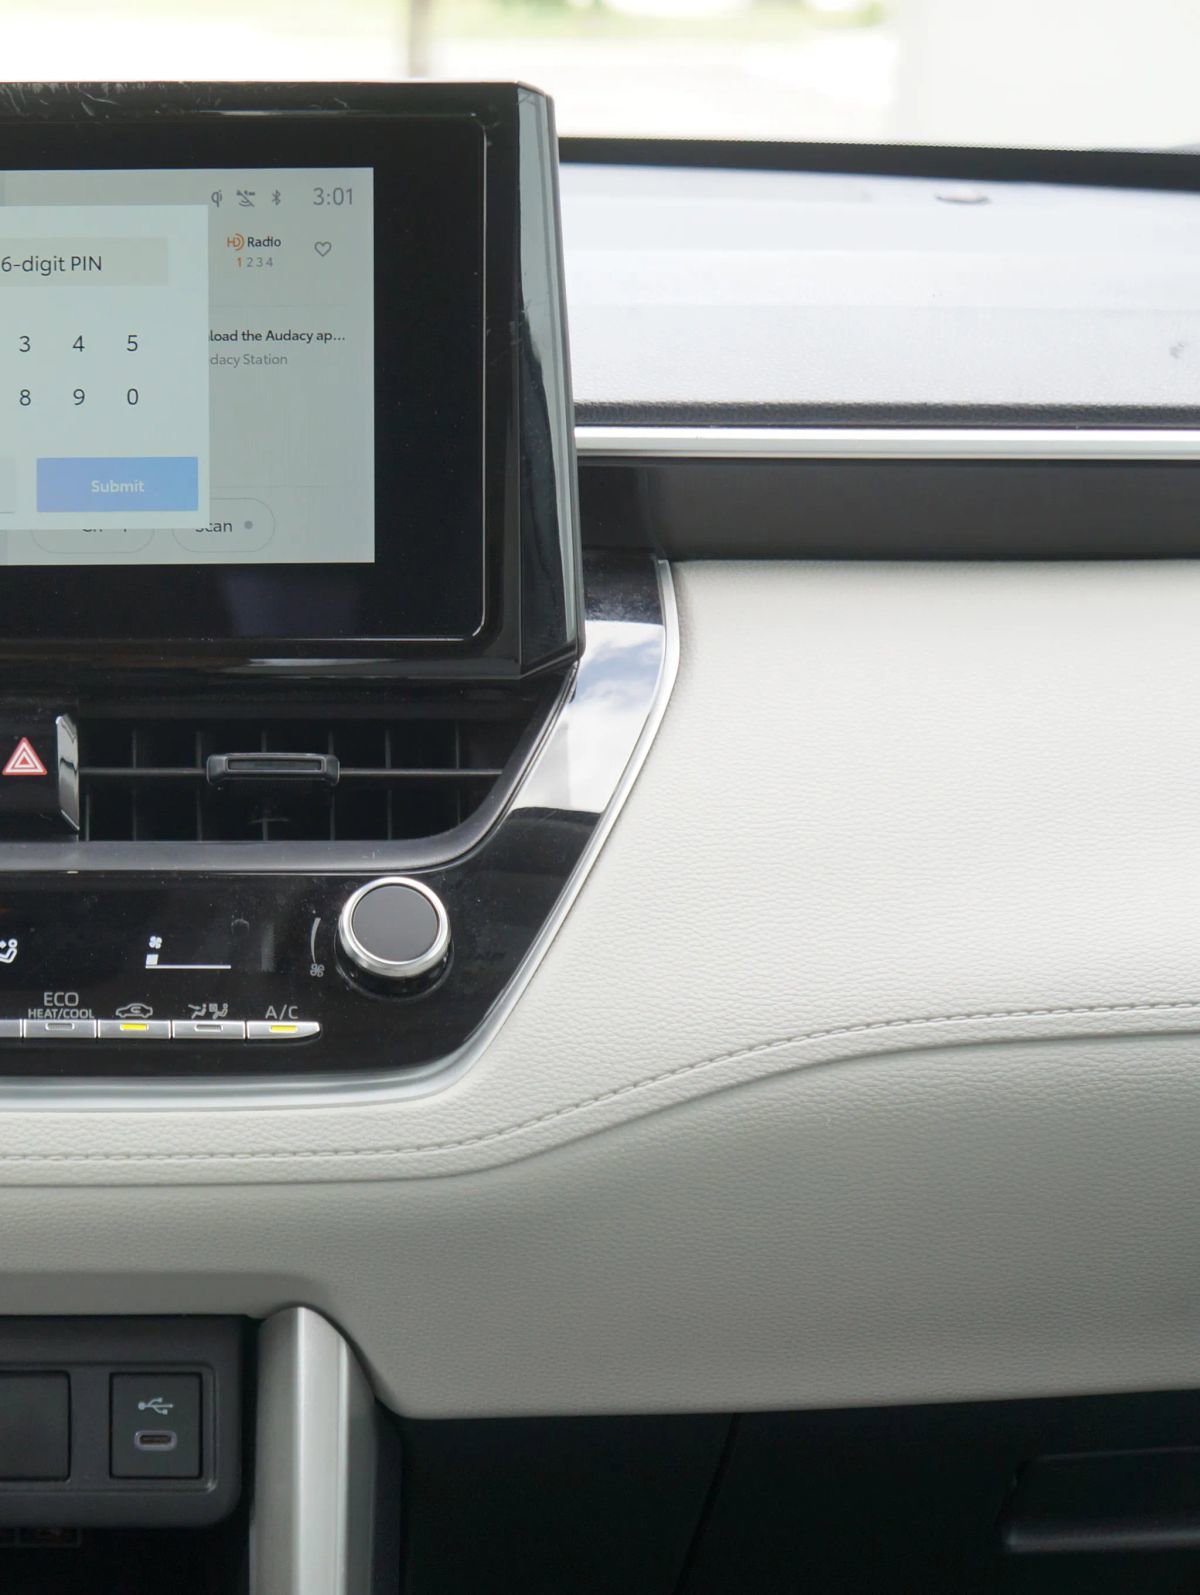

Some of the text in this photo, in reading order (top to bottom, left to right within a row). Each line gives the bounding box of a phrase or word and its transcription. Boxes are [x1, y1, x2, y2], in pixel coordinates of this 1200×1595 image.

[313, 187, 353, 206] 3:01
[247, 235, 282, 248] Radio
[1, 255, 66, 277] 6-digit
[71, 255, 102, 272] PIN
[19, 335, 31, 353] 3
[72, 335, 86, 352] 4
[126, 334, 138, 352] 5
[209, 329, 239, 342] load
[241, 329, 263, 342] the
[265, 329, 314, 345] Audacy
[242, 353, 288, 366] Station
[19, 388, 32, 406] 8
[72, 388, 86, 406] 9
[126, 388, 139, 406] 0
[90, 479, 145, 494] Submit
[43, 991, 80, 1007] ECO
[27, 1008, 95, 1020] HEAT/COOL
[264, 1004, 299, 1021] A/C
